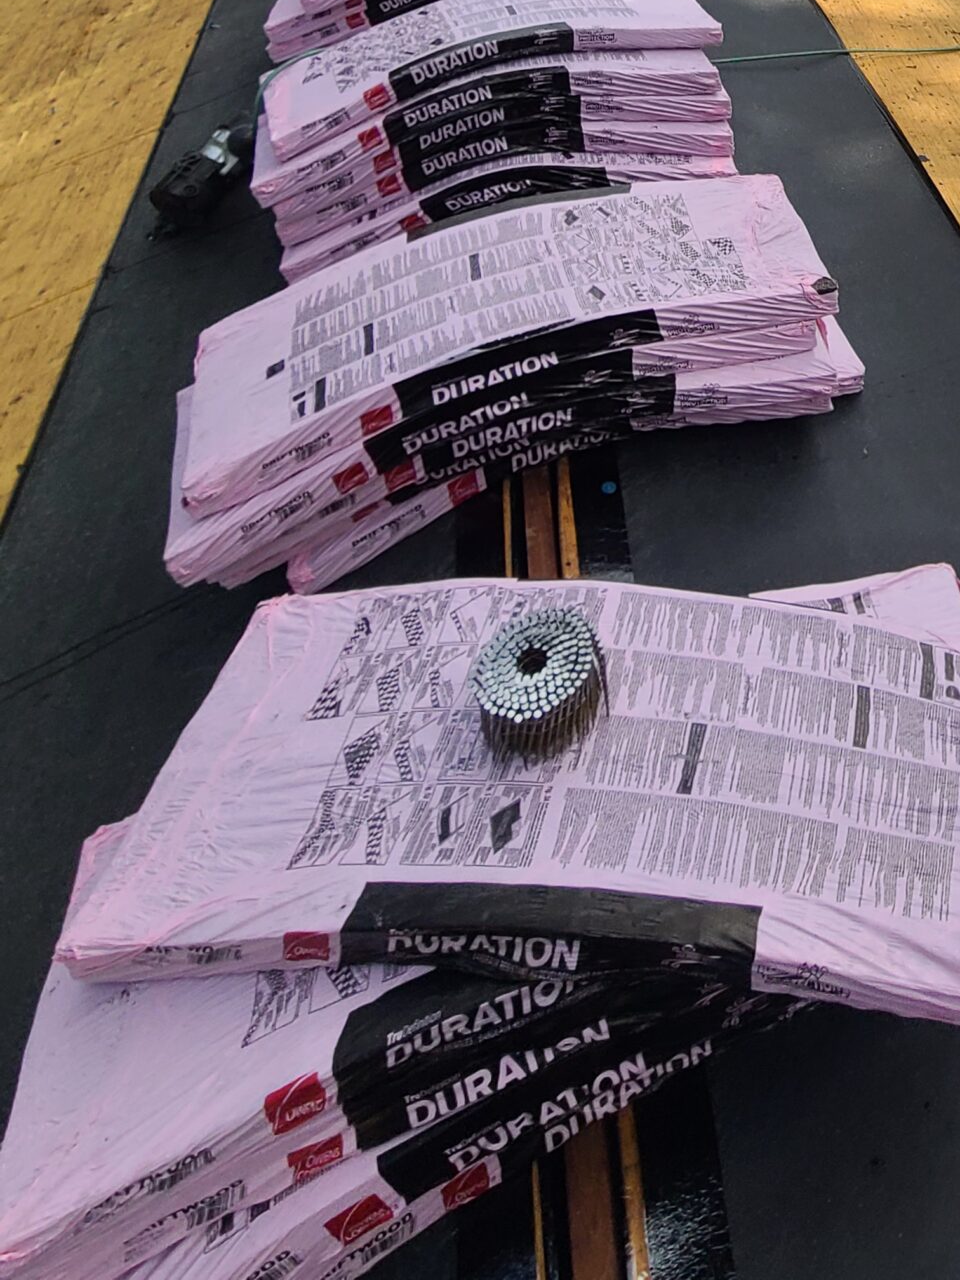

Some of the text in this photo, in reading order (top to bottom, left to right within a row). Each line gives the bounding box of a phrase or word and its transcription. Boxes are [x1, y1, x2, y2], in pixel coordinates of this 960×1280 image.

[410, 39, 499, 85] DURATION
[403, 85, 493, 128] DURATION
[419, 106, 505, 150] DURATION
[420, 136, 509, 176] DURATION
[431, 351, 559, 406] DURATION
[402, 392, 529, 455] DURATION
[452, 407, 572, 458] DURATION
